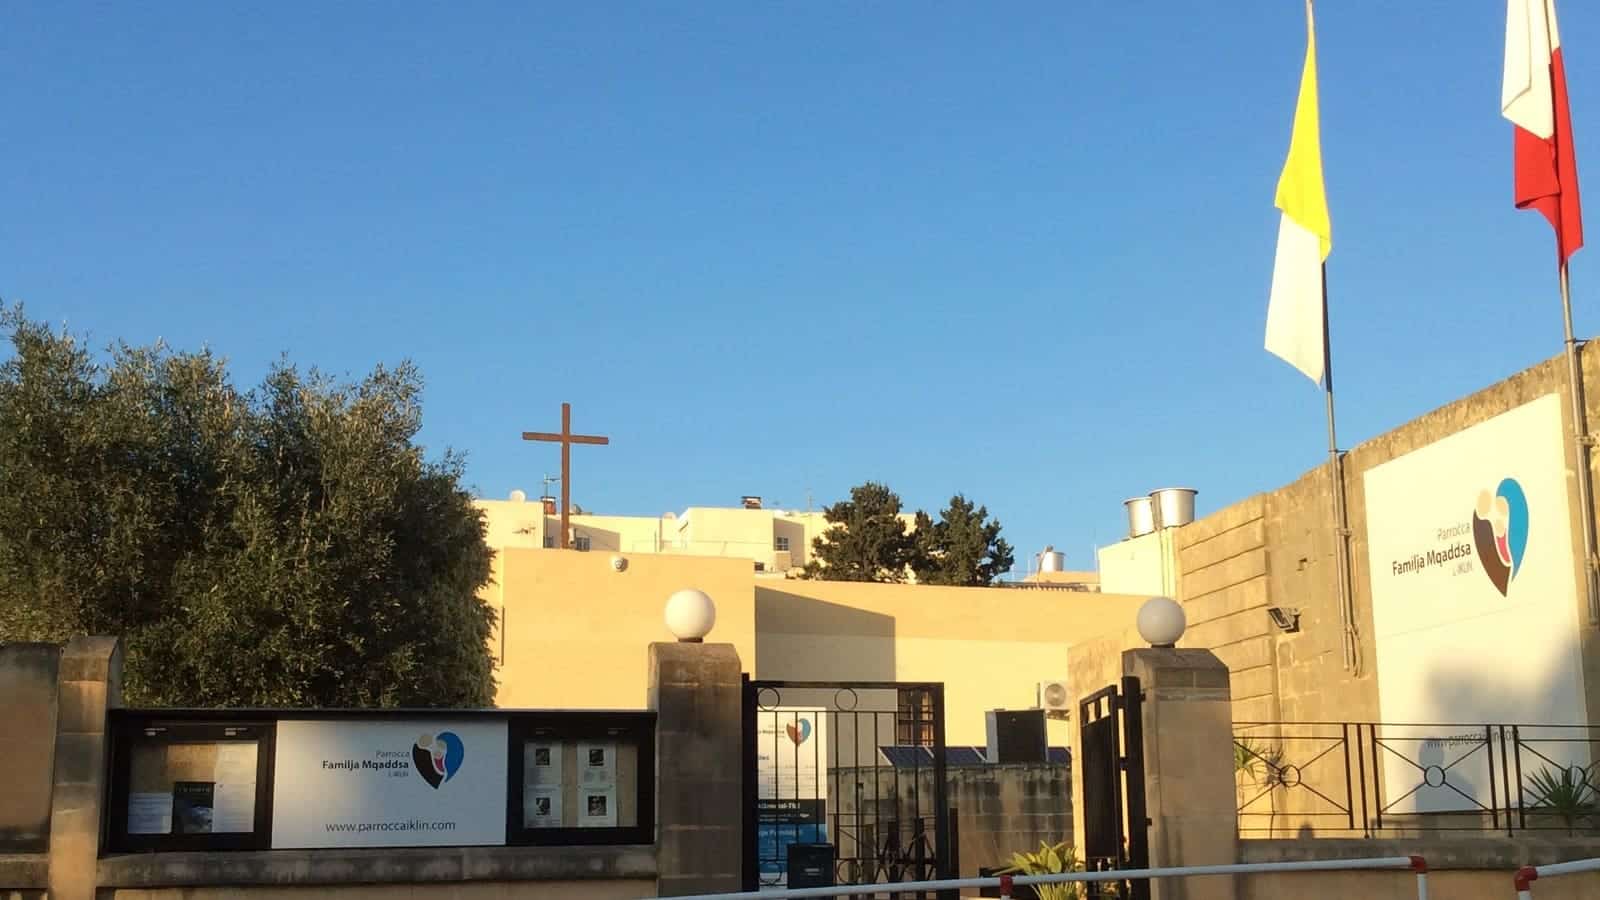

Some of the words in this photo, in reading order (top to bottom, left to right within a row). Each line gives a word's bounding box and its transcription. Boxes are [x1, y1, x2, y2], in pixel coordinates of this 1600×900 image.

[1392, 553, 1425, 576] Familja
[1426, 542, 1472, 567] Mqaddsa
[322, 759, 360, 771] Familja
[361, 759, 409, 771] Mqaddsa
[325, 818, 456, 833] www.parroccaiklin.com
